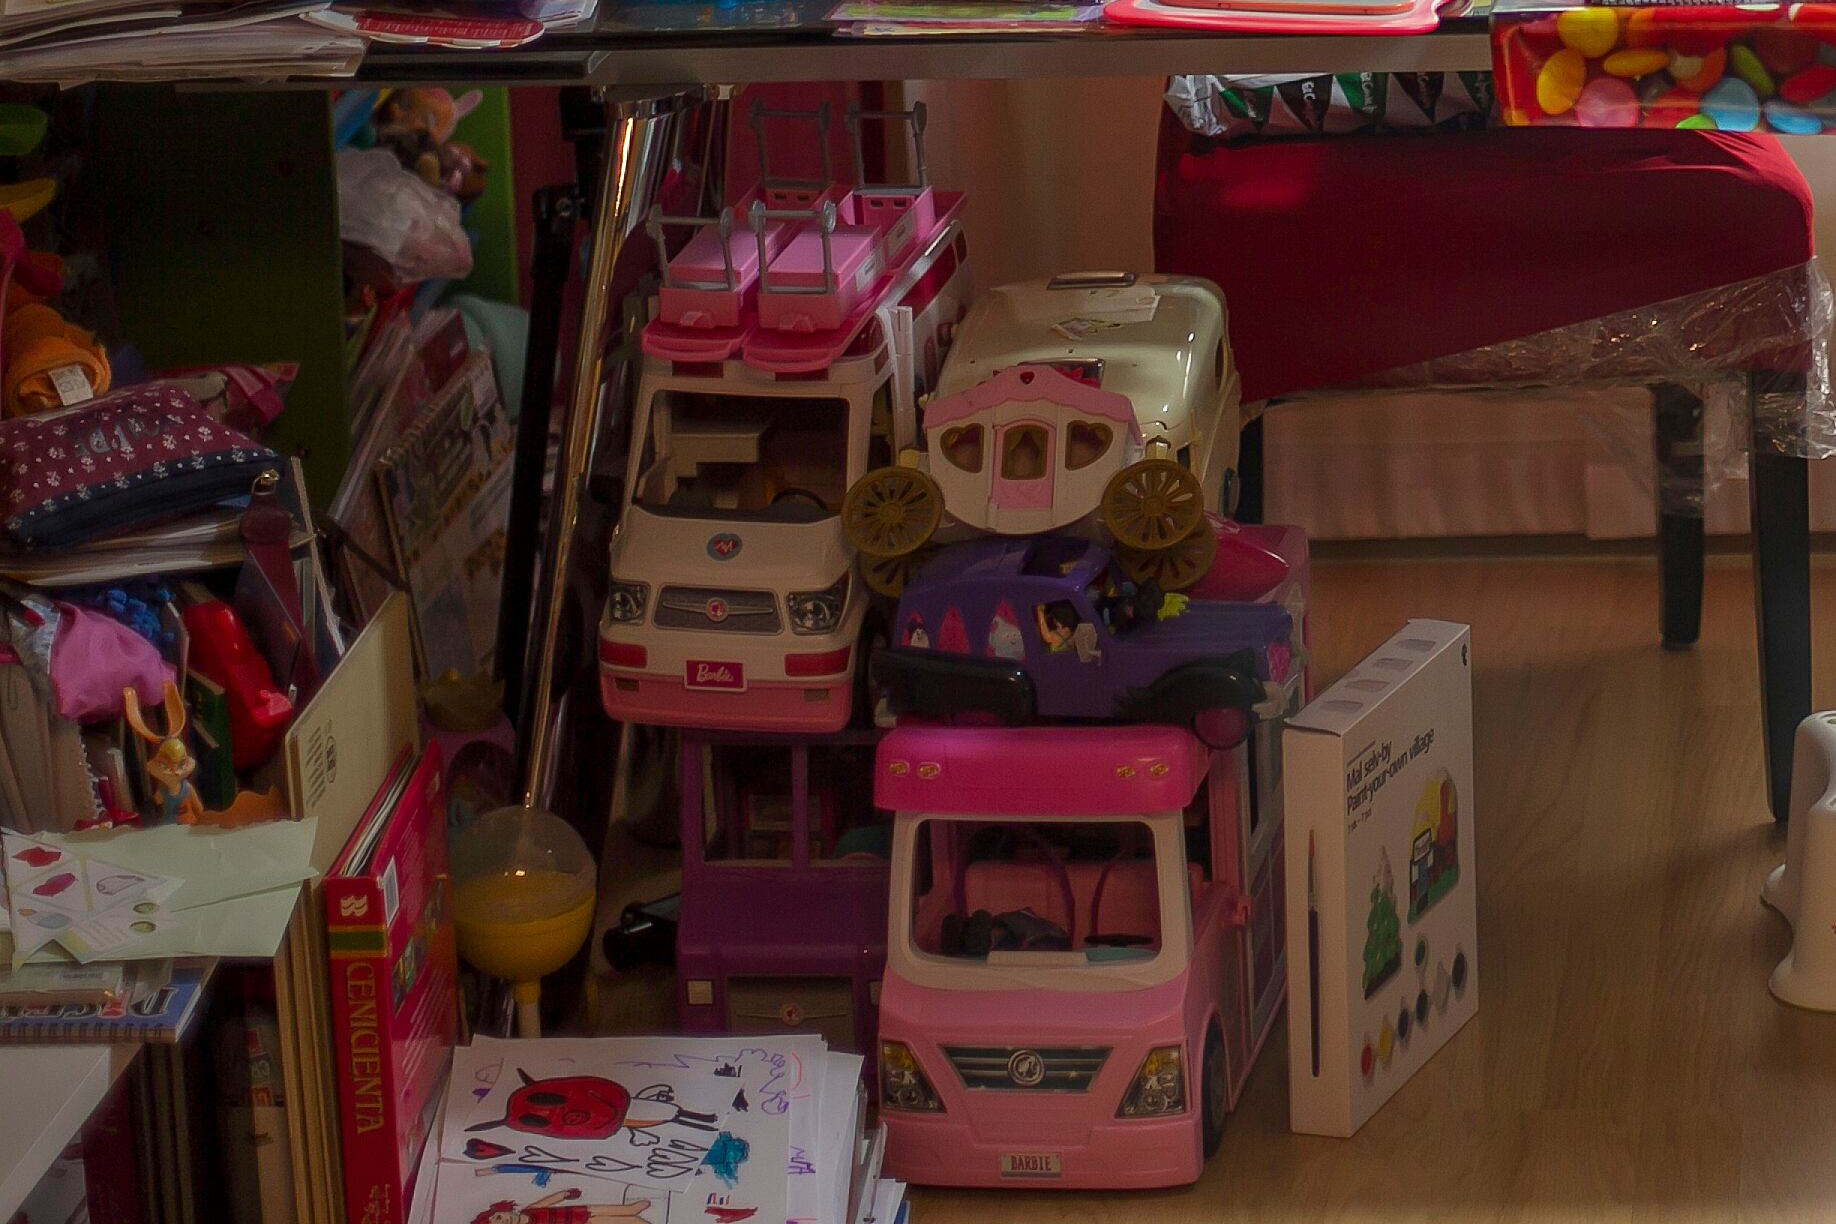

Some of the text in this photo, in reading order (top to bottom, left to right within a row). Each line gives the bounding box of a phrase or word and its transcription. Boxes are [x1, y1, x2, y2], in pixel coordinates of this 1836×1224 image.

[696, 663, 735, 682] Barbie
[1409, 728, 1435, 760] village
[1347, 761, 1363, 793] Mal
[346, 961, 385, 1135] CENICIENTA
[1010, 1155, 1052, 1171] BARBIE
